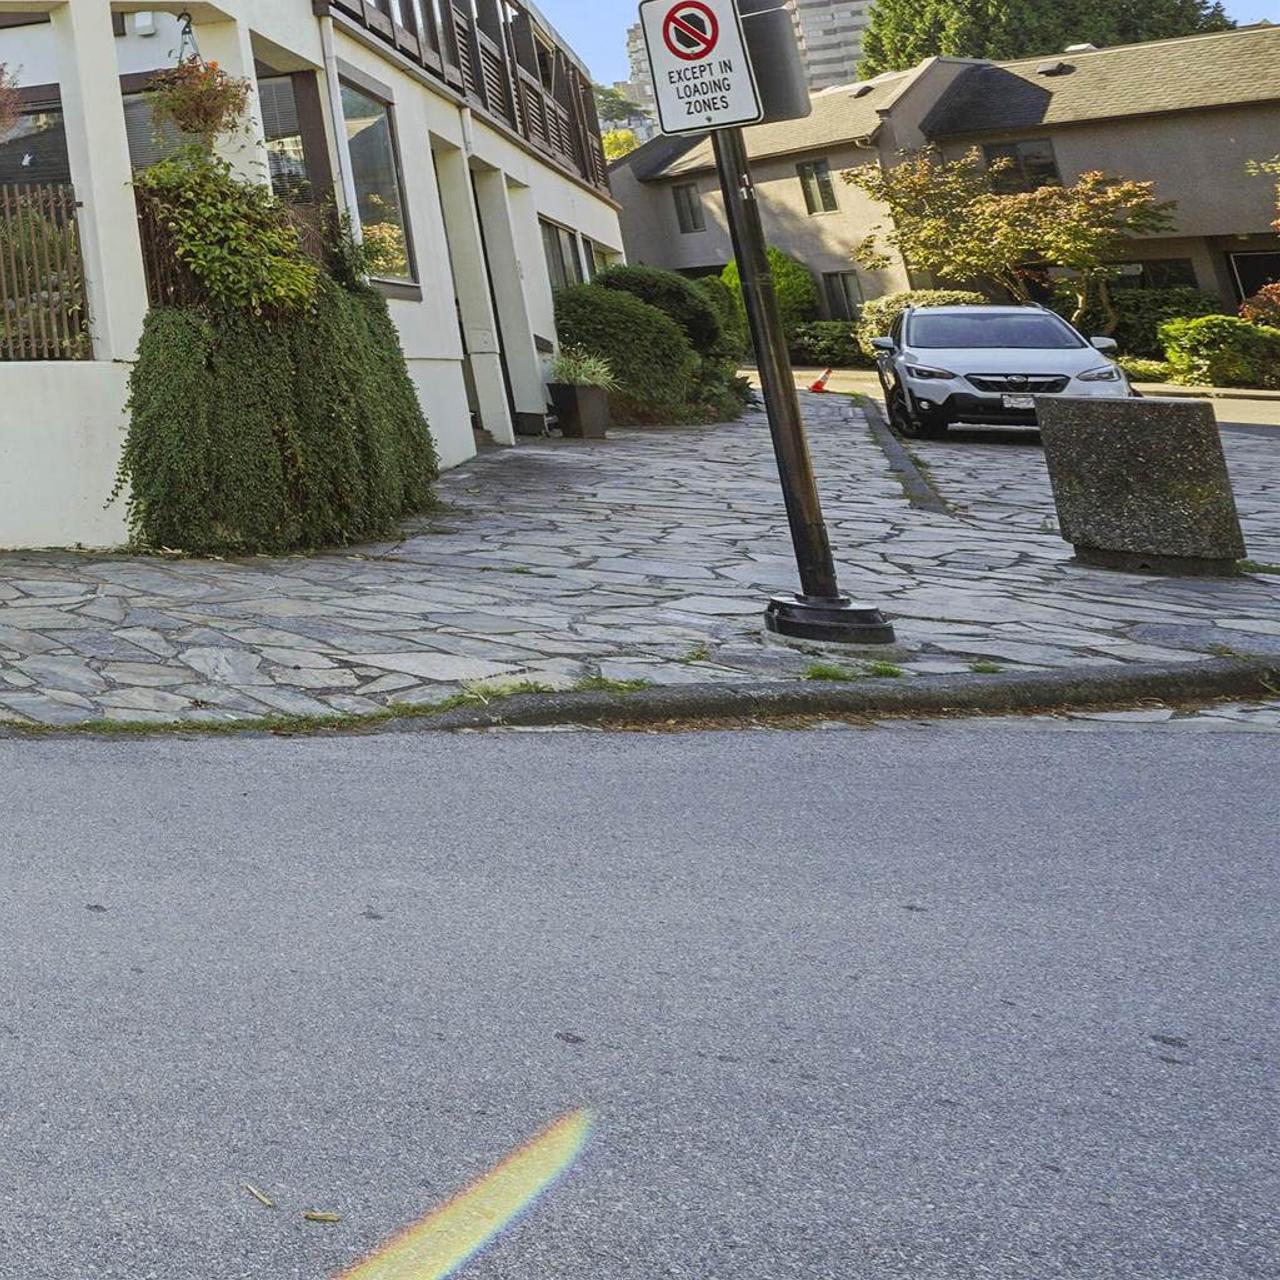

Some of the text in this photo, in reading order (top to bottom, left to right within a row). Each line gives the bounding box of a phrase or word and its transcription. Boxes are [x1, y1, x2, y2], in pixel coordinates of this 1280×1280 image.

[668, 59, 733, 84] EXCEPT IN
[676, 77, 731, 100] LOADING
[685, 95, 729, 115] ZONES
